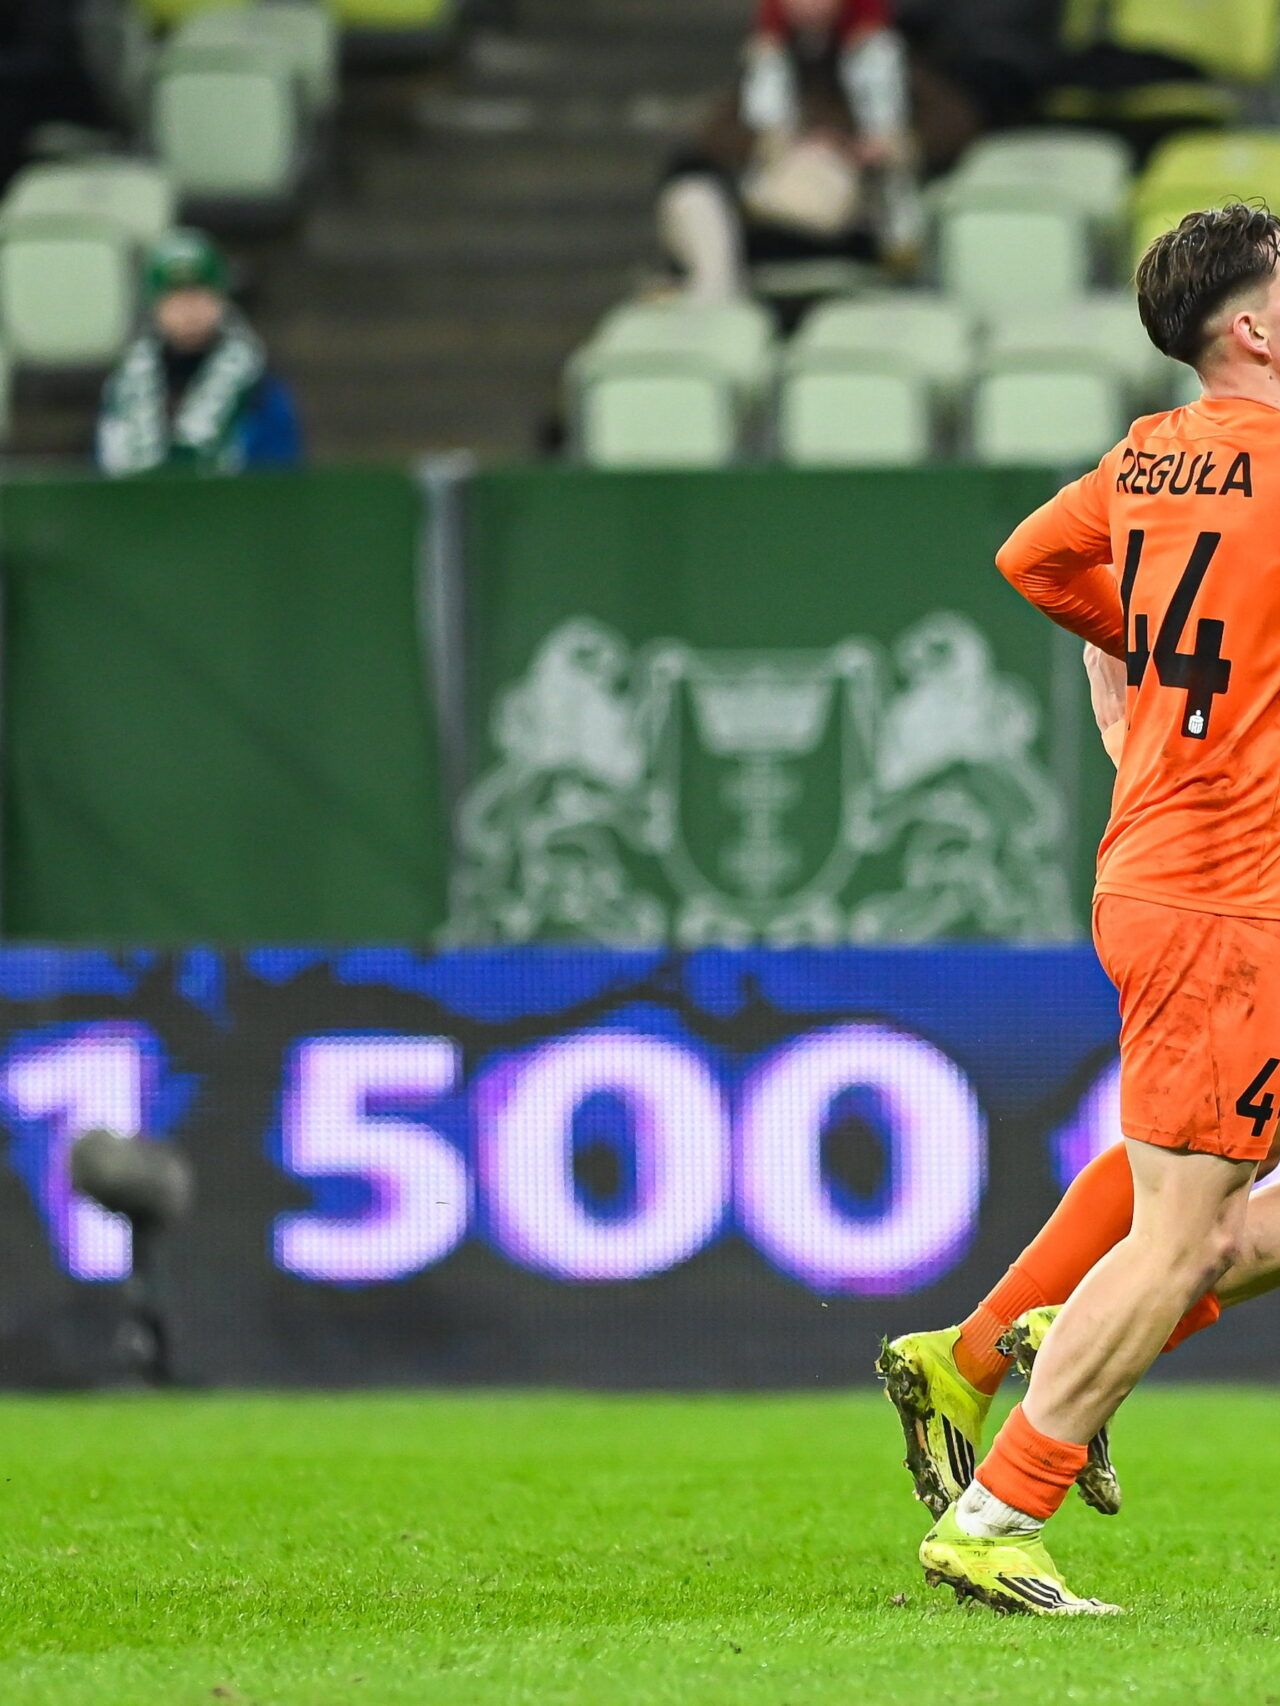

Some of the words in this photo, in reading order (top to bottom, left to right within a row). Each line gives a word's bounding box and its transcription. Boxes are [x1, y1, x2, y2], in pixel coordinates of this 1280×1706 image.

[1116, 447, 1253, 497] REGUŁA
[1120, 529, 1232, 740] 44
[2, 1028, 146, 1282] 1
[272, 1024, 987, 1292] 500
